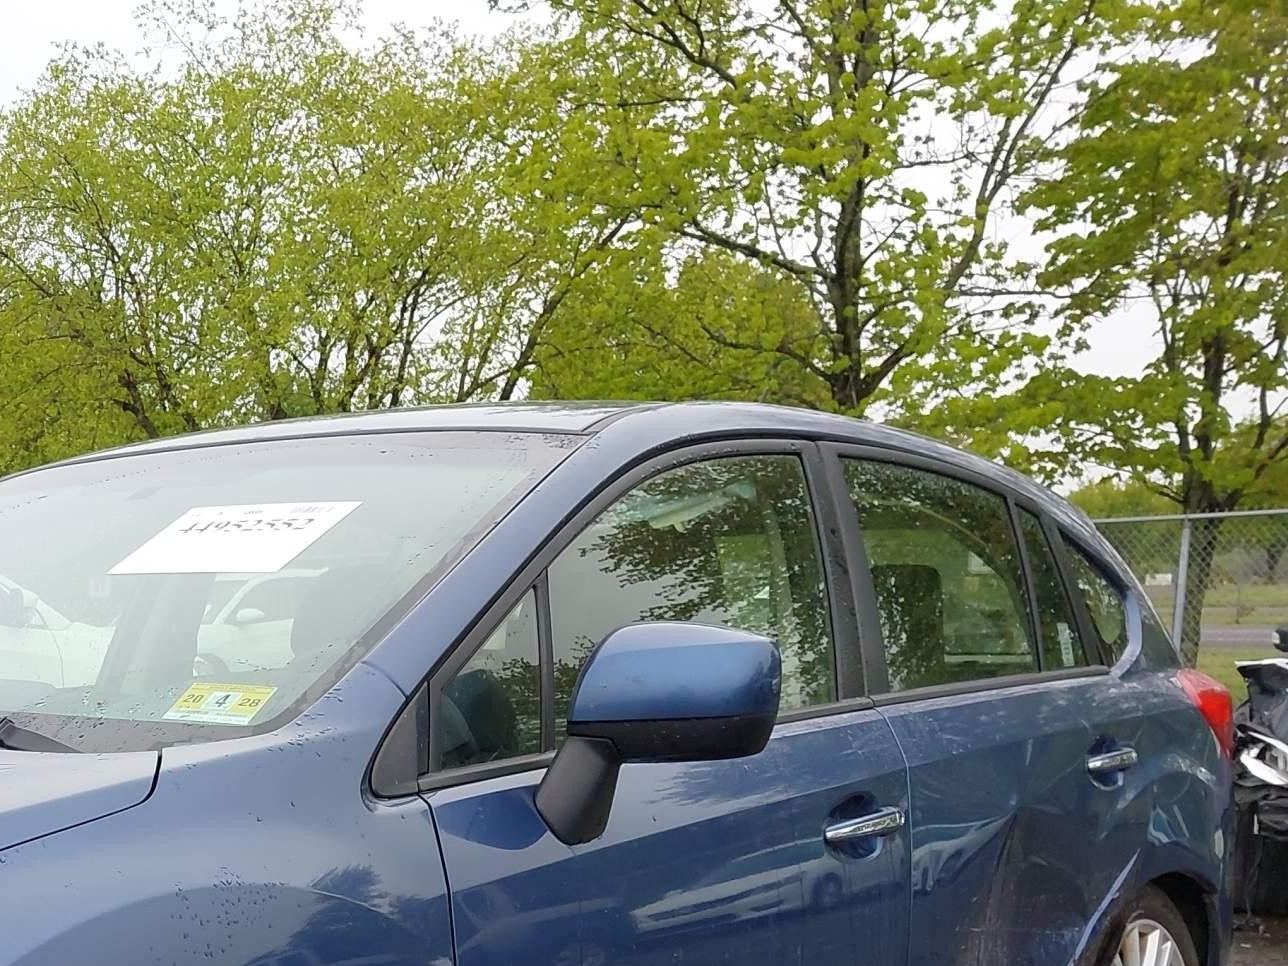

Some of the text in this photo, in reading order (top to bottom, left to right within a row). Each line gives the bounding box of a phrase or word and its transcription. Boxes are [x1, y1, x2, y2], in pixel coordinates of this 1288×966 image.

[179, 518, 316, 533] 44952552
[183, 694, 204, 704] 20
[215, 694, 232, 708] 4
